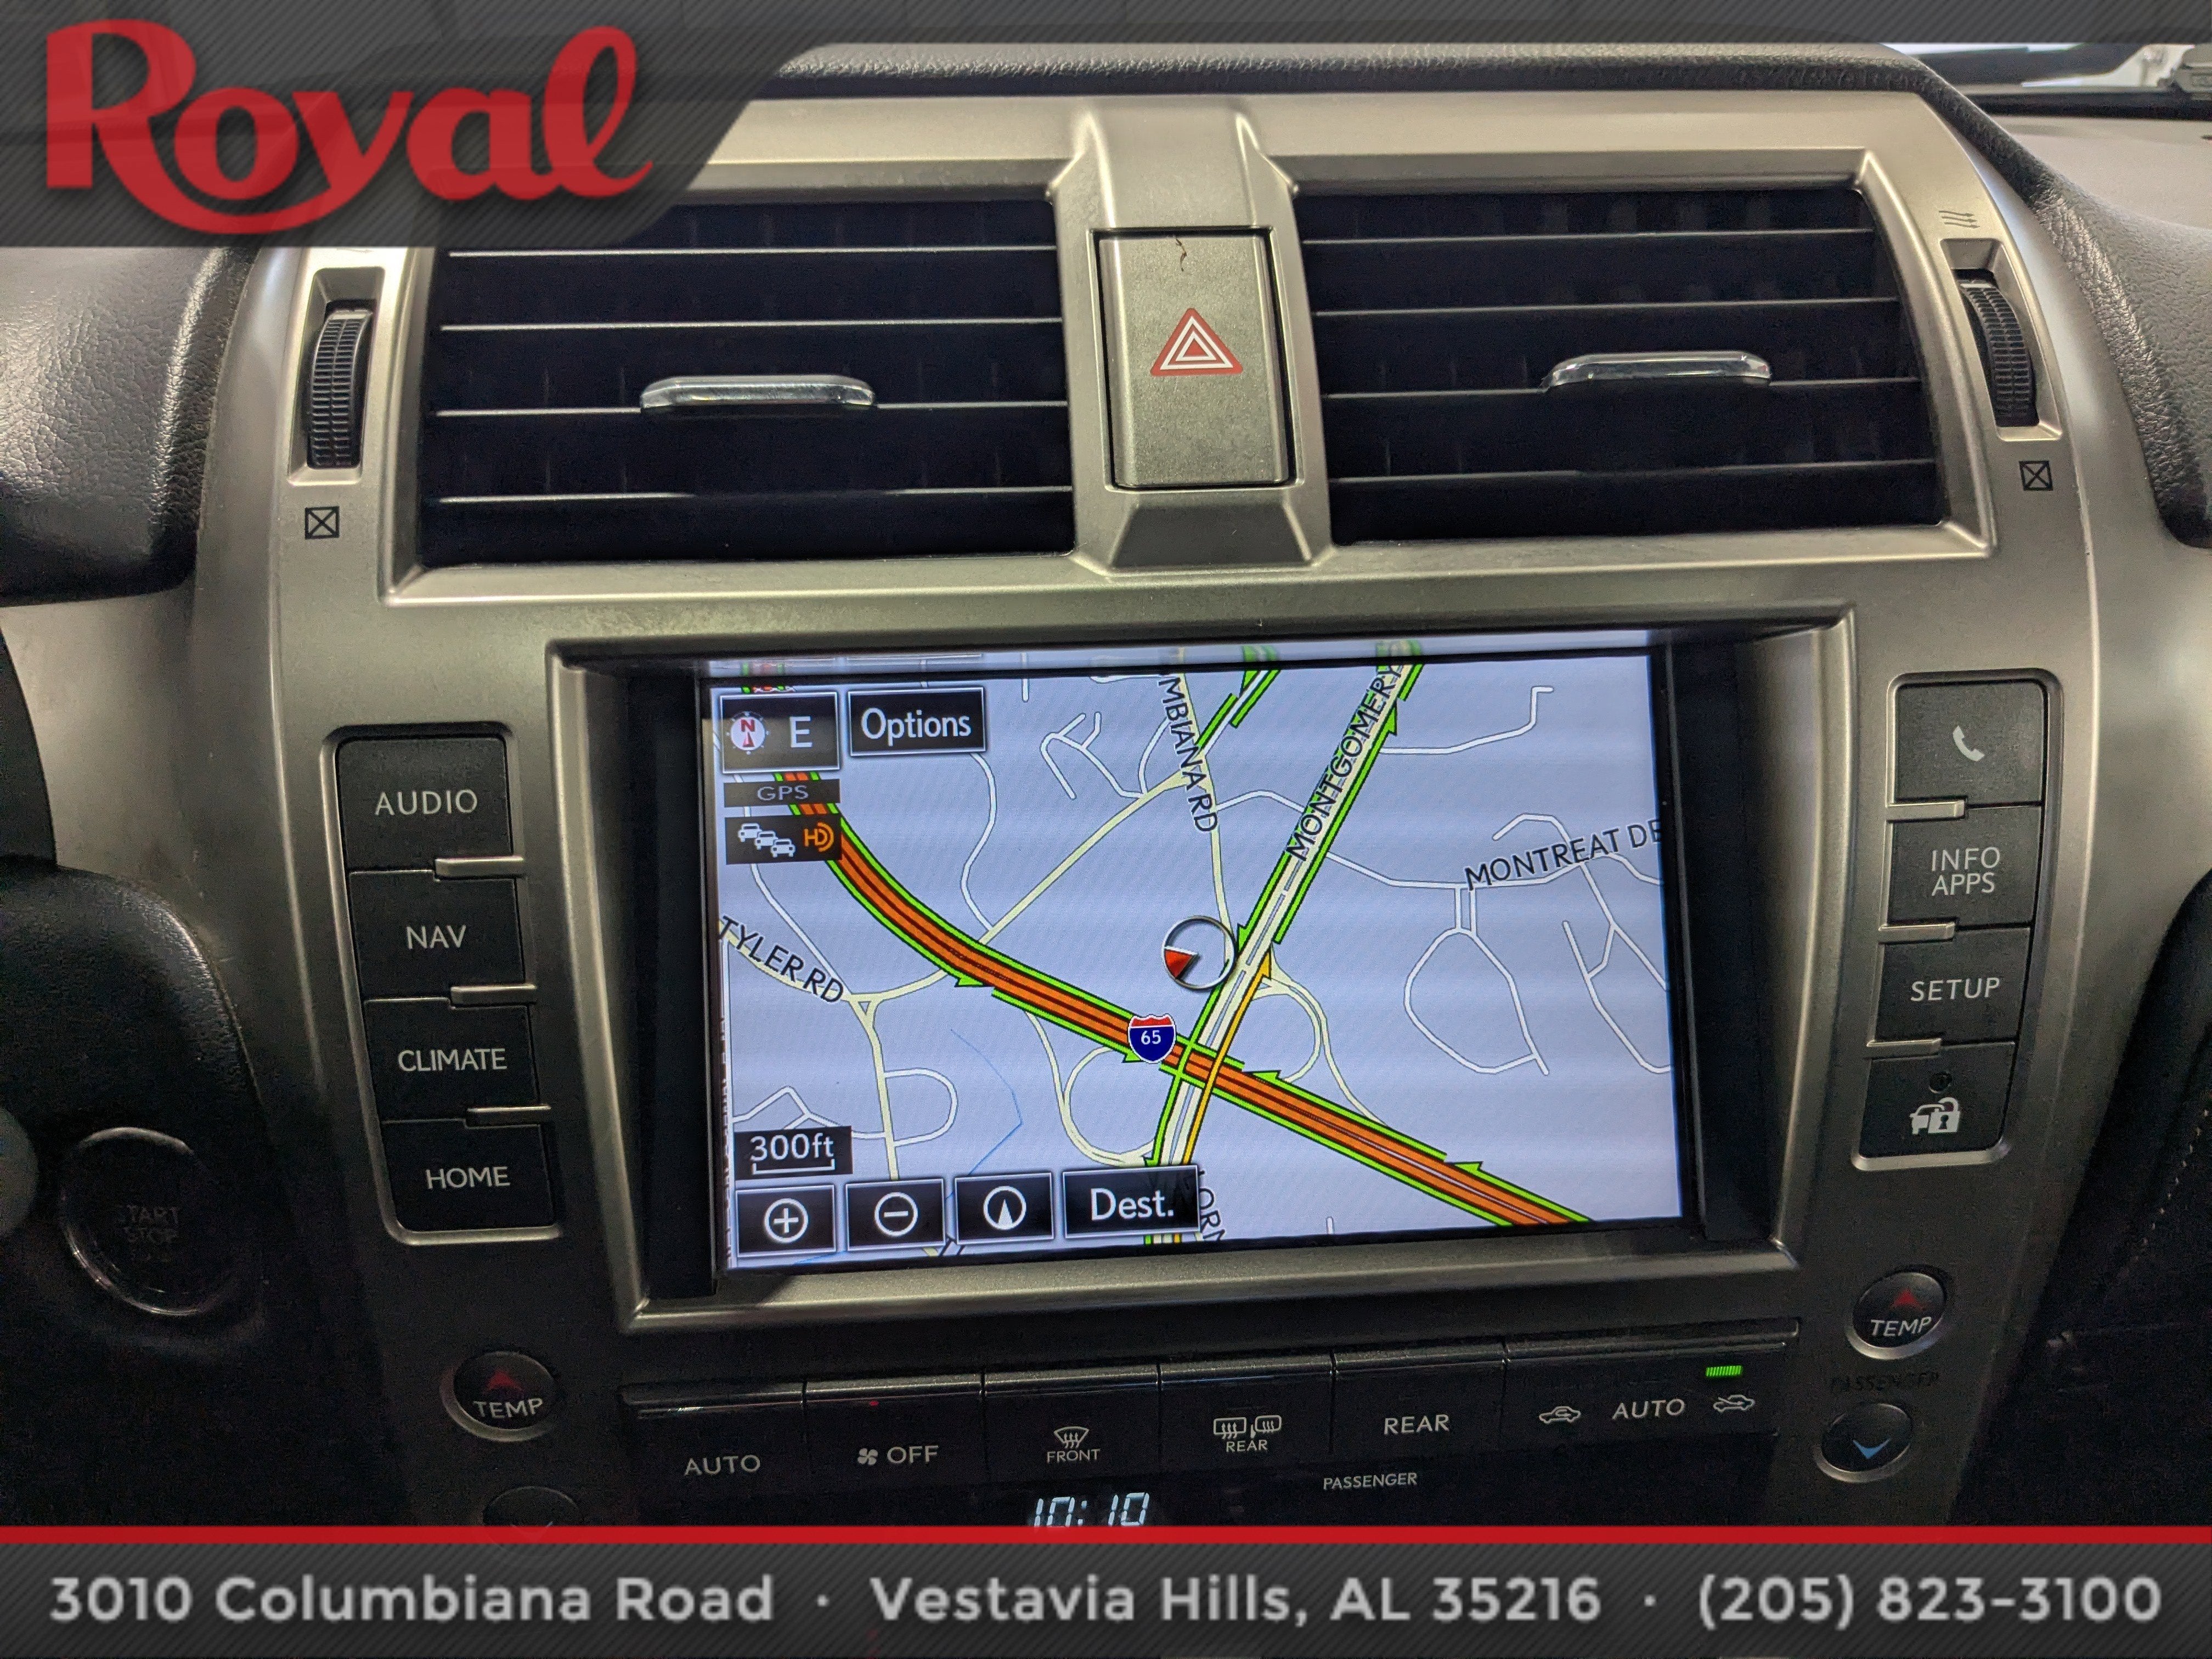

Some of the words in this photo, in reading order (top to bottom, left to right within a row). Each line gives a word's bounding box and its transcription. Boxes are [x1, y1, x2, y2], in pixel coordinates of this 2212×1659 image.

[789, 716, 813, 748] E
[861, 708, 971, 746] Options
[1158, 672, 1206, 790] MBIANA
[1188, 793, 1217, 832] RD
[1286, 664, 1403, 861] MONTGOMERY
[375, 789, 478, 815] AUDIO
[757, 785, 809, 801] GPS
[1465, 828, 1619, 890] MONTREAT
[1931, 847, 2000, 872] INFO
[1931, 873, 1996, 896] APPS
[406, 924, 466, 950] NAV
[719, 916, 805, 982] TYLER
[804, 968, 844, 1003] RD
[1911, 977, 2000, 1002] SETUP
[1141, 1030, 1161, 1045] 65
[398, 1048, 507, 1071] CLIMATE
[750, 1133, 834, 1162] 300ft
[425, 1166, 510, 1189] HOME
[1091, 1187, 1174, 1221] Dest.
[1870, 1317, 1932, 1338] TEMP
[473, 1398, 543, 1419] TEMP
[1612, 1399, 1686, 1421] AUTO
[1384, 1414, 1450, 1436] REAR
[887, 1445, 939, 1464] OFF
[1047, 1448, 1100, 1463] FRONT
[1226, 1440, 1268, 1453] REAR
[685, 1454, 761, 1477] AUTO
[1323, 1472, 1418, 1491] PASSENGER
[1034, 1492, 1150, 1527] 10:10
